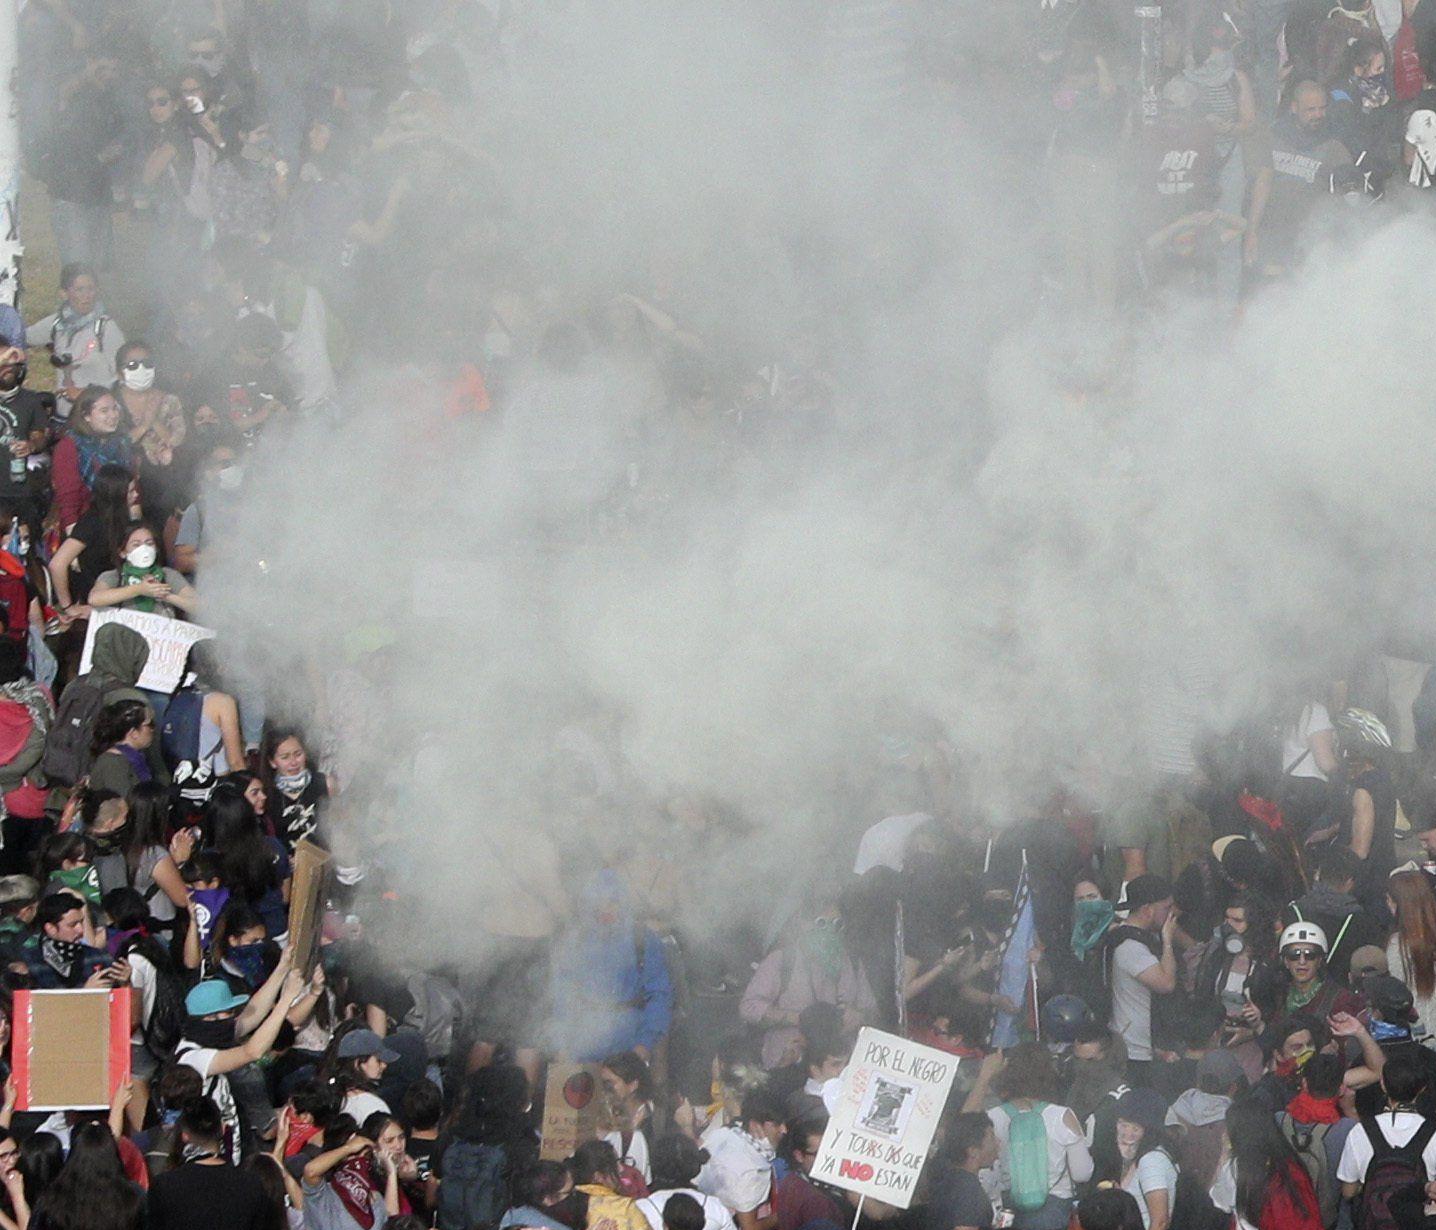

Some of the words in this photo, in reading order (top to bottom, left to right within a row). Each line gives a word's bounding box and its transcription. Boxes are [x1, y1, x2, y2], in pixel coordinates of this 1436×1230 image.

[864, 1041, 891, 1067] POR
[892, 1050, 905, 1073] EL
[907, 1056, 947, 1084] NEGRO
[820, 1154, 836, 1175] YA
[838, 1158, 874, 1182] NO
[830, 1128, 844, 1149] Y
[902, 1153, 925, 1171] QUE
